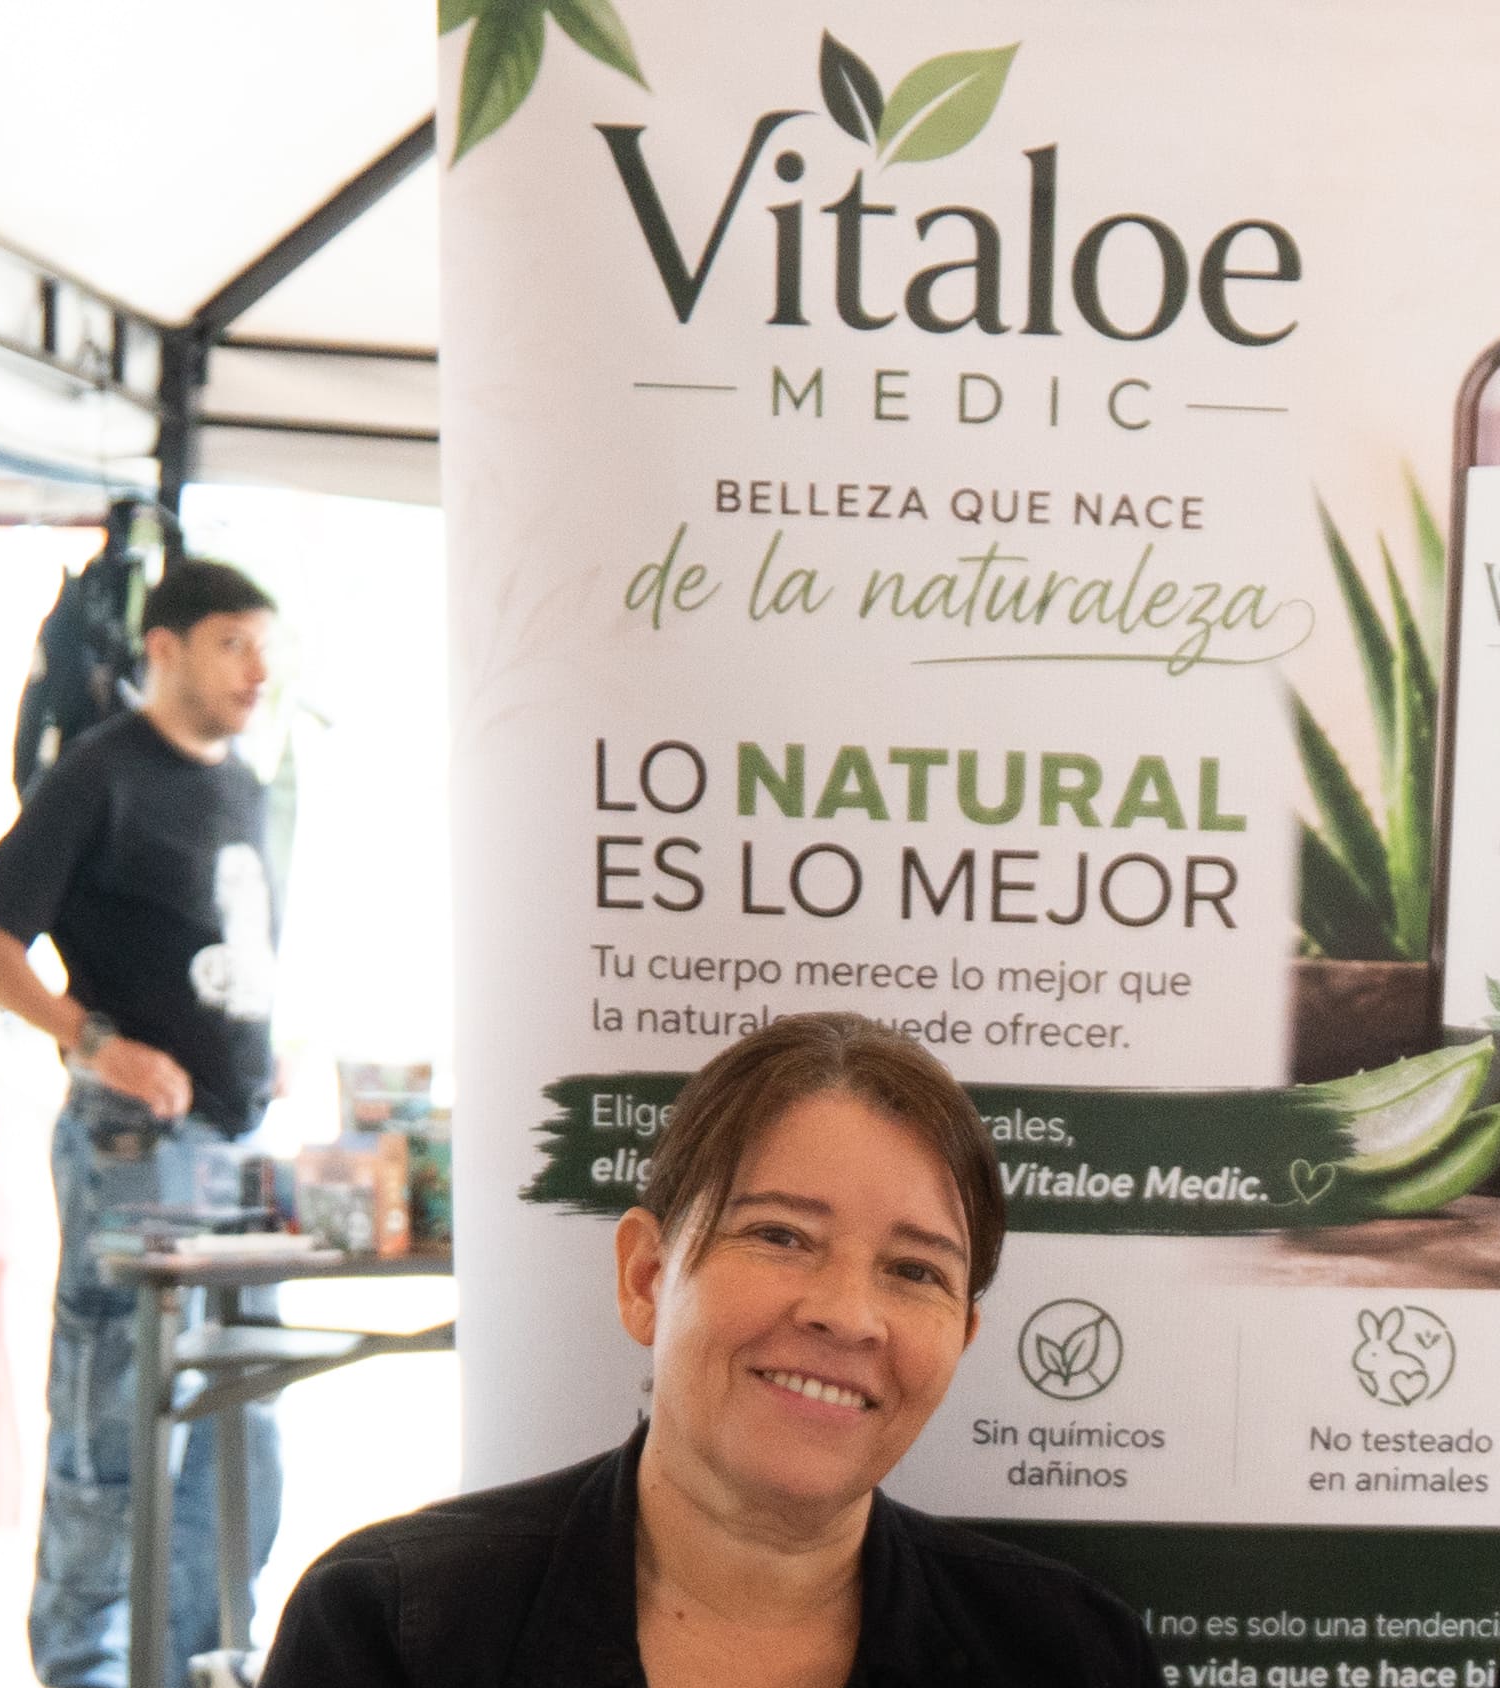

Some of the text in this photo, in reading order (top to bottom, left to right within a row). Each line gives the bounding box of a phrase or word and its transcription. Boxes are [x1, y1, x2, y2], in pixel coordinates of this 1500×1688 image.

[593, 110, 1301, 345] Vitaloe
[771, 366, 1152, 431] MEDIC
[714, 479, 1205, 531] BELLEZA QUE NACE
[625, 521, 1300, 676] de la naturaleza
[595, 738, 1247, 832] LO NATURAL
[595, 836, 1239, 929] ES LO MEJOR
[591, 945, 1192, 1003] Tu cuerpo merece lo mejor que
[593, 1000, 1130, 1048] la natural ofrecer.
[593, 1094, 676, 1136] Elige
[591, 1148, 652, 1191] elig
[1001, 1163, 1269, 1202] Vitaloe Medic.
[972, 1419, 1165, 1458] Sin químicos
[1309, 1427, 1493, 1455] No testeado
[1007, 1460, 1126, 1488] dañinos
[1309, 1467, 1488, 1494] en animales
[1160, 1615, 1197, 1635] no
[1206, 1615, 1238, 1636] es
[1246, 1610, 1307, 1637] solo
[1314, 1616, 1367, 1638] una
[1163, 1665, 1180, 1686] e
[1190, 1658, 1258, 1688] vida
[1338, 1661, 1371, 1688] te
[1379, 1659, 1457, 1688] hace
[1465, 1659, 1497, 1688] bi
